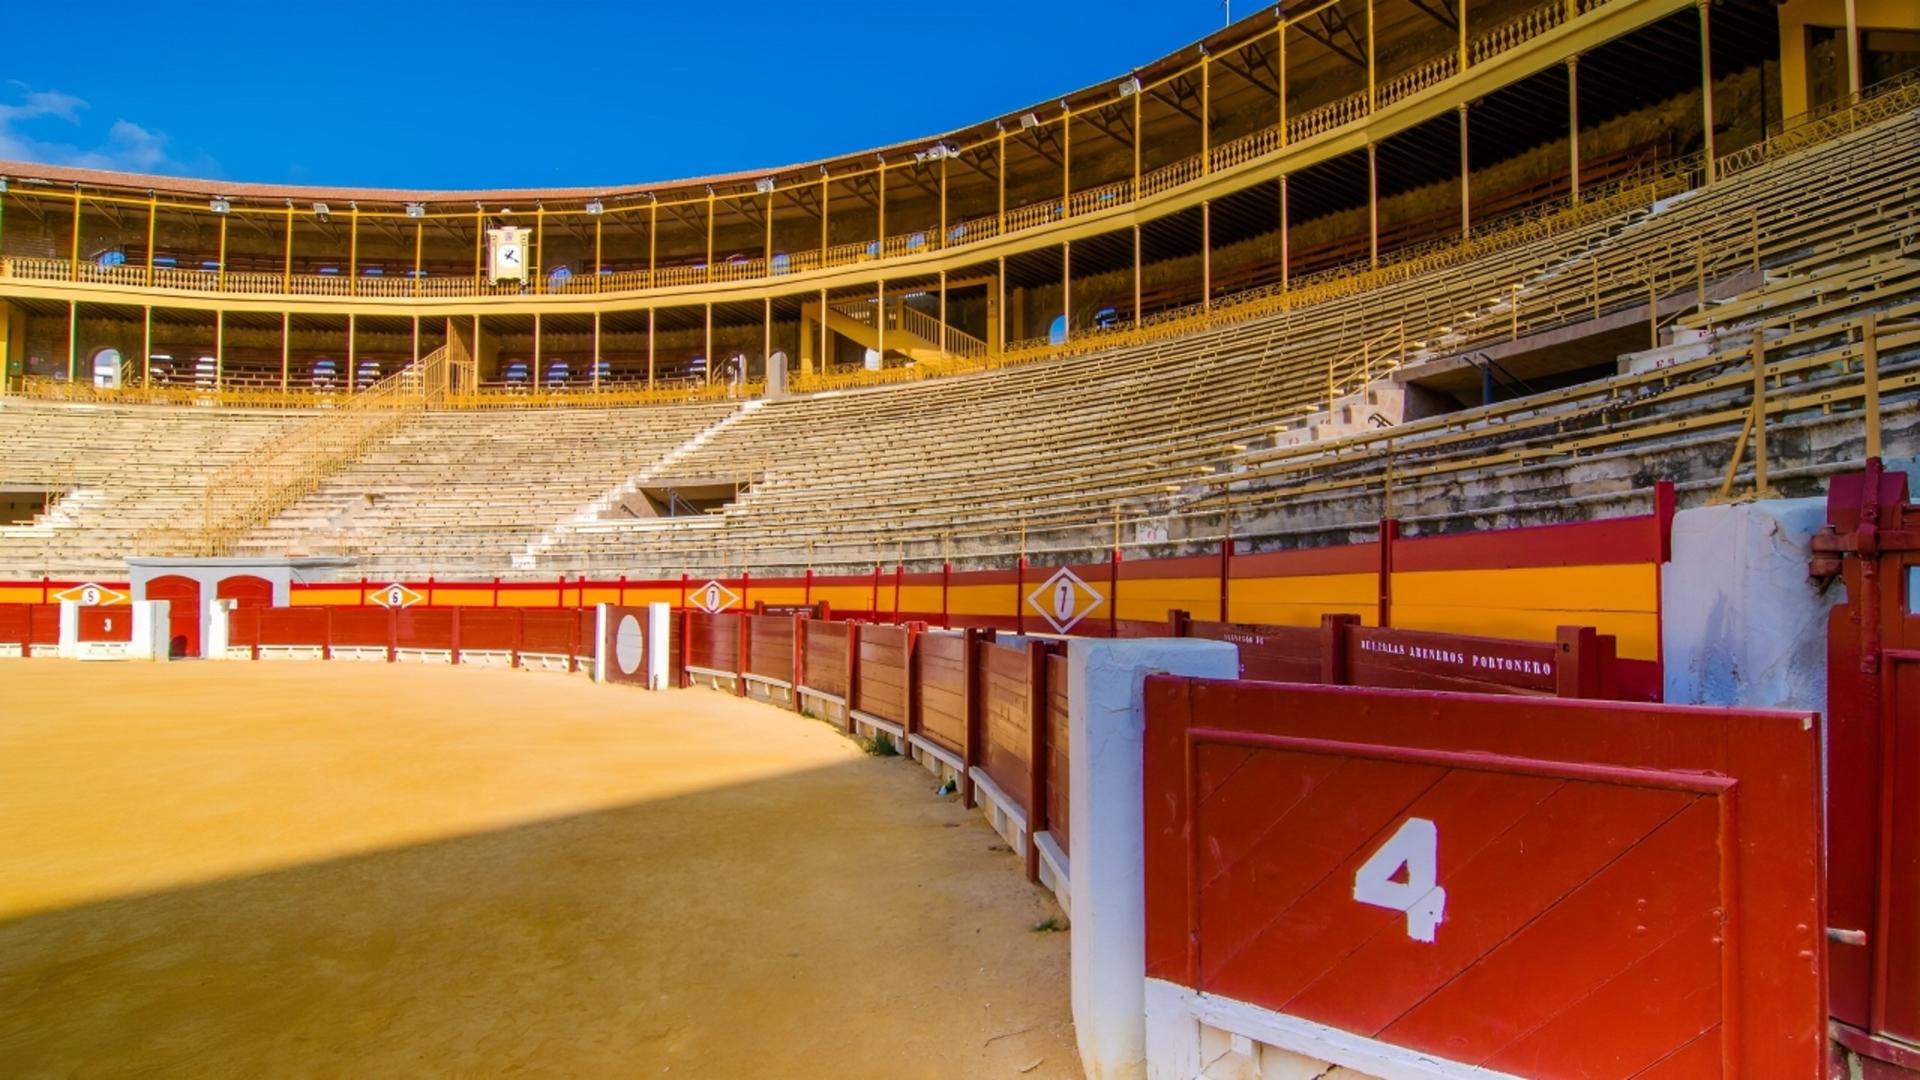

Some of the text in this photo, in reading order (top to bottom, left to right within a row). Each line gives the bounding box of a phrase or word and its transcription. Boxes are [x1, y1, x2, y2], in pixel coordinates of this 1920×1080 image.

[87, 591, 94, 602] 5
[392, 592, 399, 604] 6
[1061, 586, 1068, 613] 7
[103, 617, 112, 633] 3
[1409, 646, 1464, 664] ARENEROS
[1471, 654, 1551, 677] PORTONERO
[1353, 817, 1447, 943] 4
